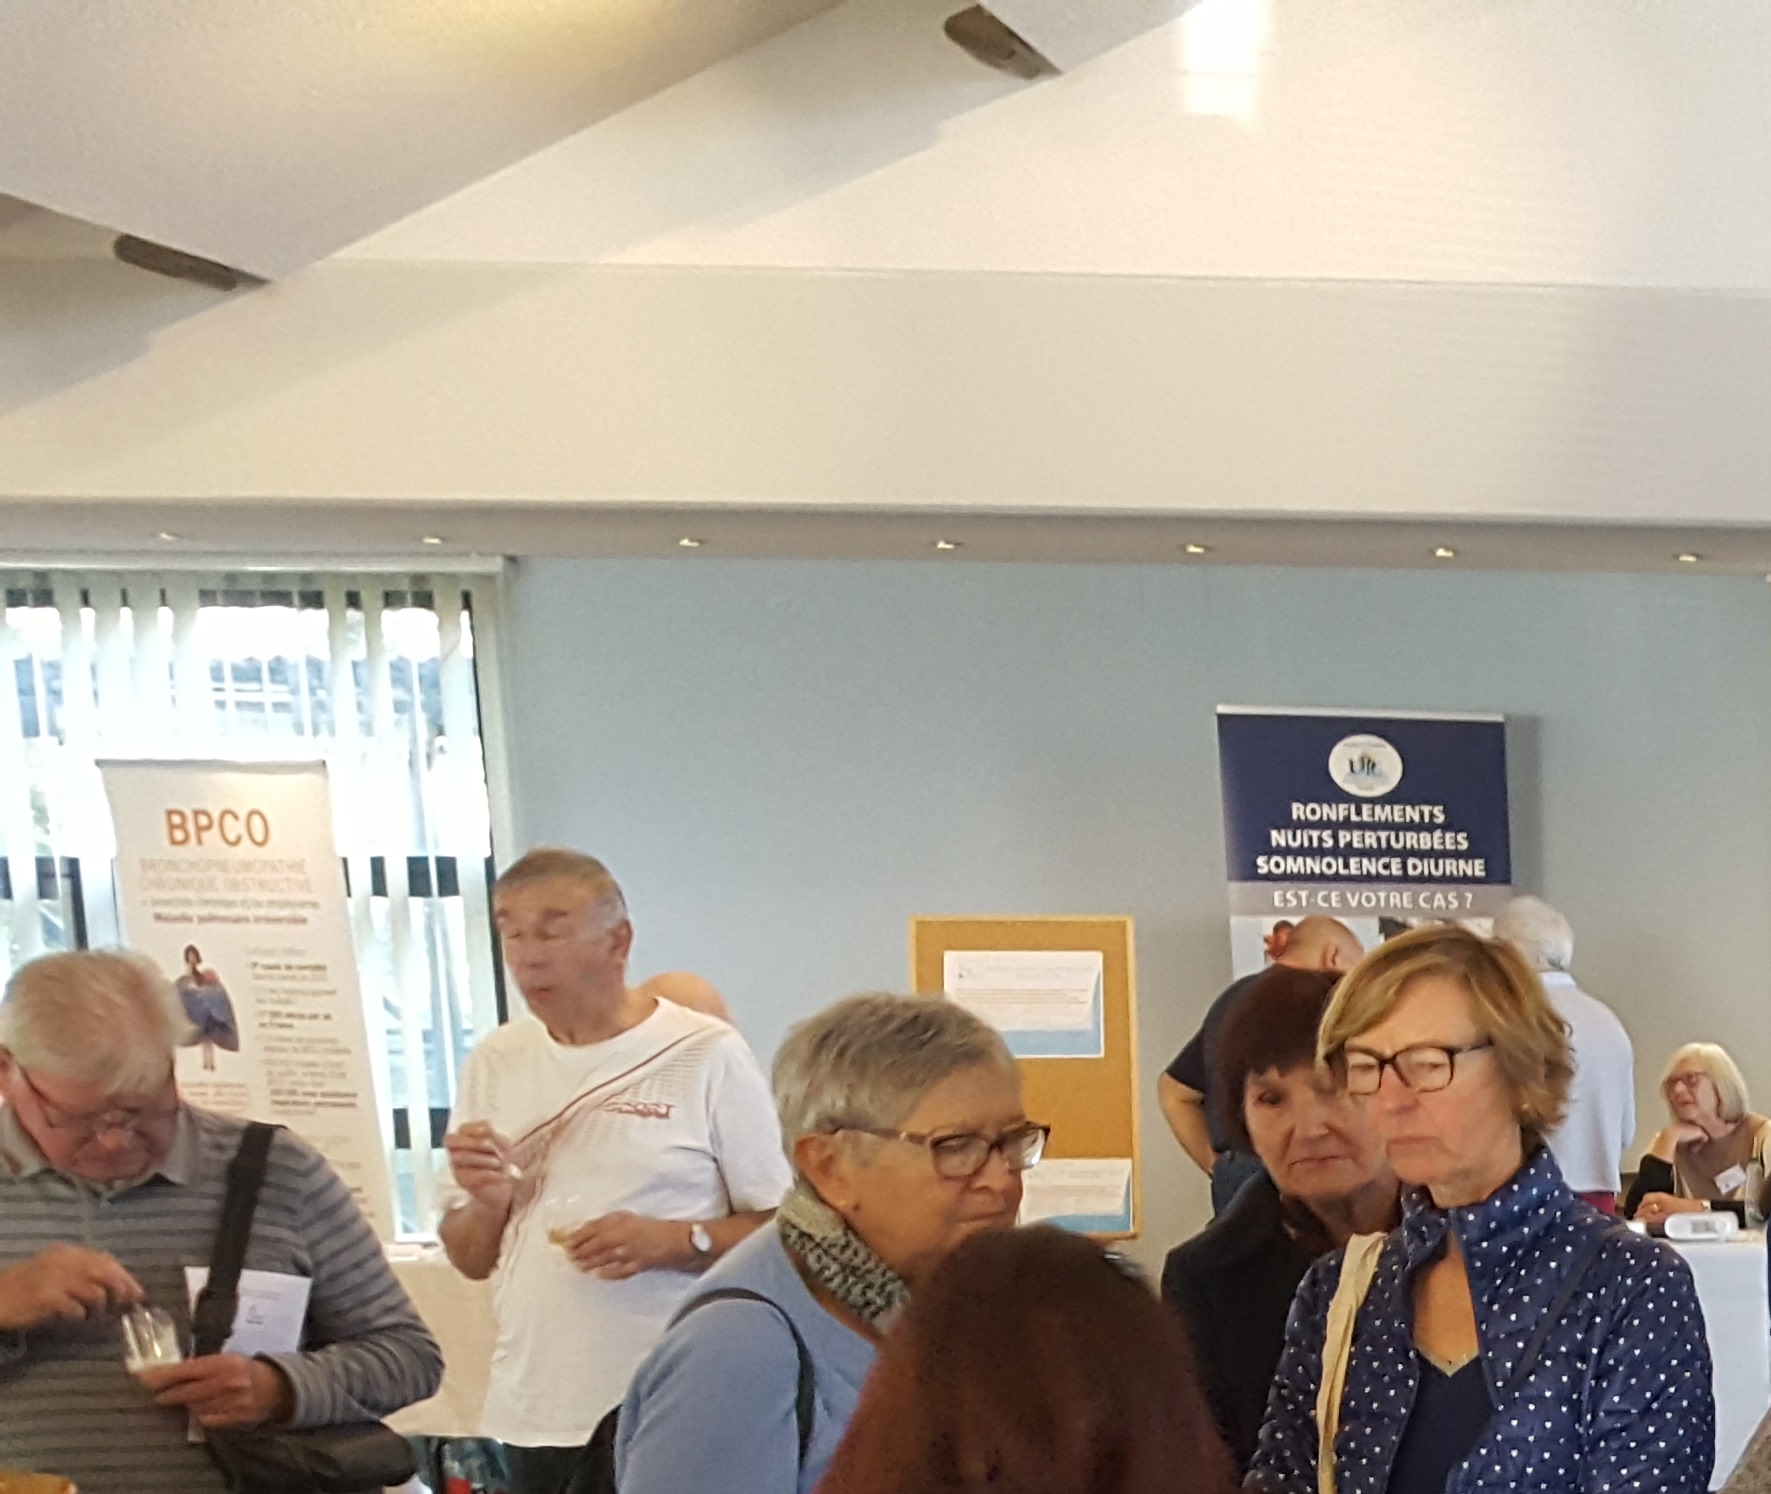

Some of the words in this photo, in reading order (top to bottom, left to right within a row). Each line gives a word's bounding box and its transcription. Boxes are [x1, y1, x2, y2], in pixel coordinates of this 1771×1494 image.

[1291, 802, 1446, 824] RONFLEMENTS
[164, 807, 271, 847] BPCO
[1270, 829, 1334, 848] NUITS
[1339, 829, 1470, 850] PERTURBÉES
[1256, 855, 1403, 876] SOMNOLENCE
[1407, 858, 1486, 877] DIURNE
[1273, 889, 1342, 909] EST-CE
[1346, 891, 1414, 909] VOTRE
[1418, 891, 1459, 909] CAS
[1463, 892, 1473, 909] ?
